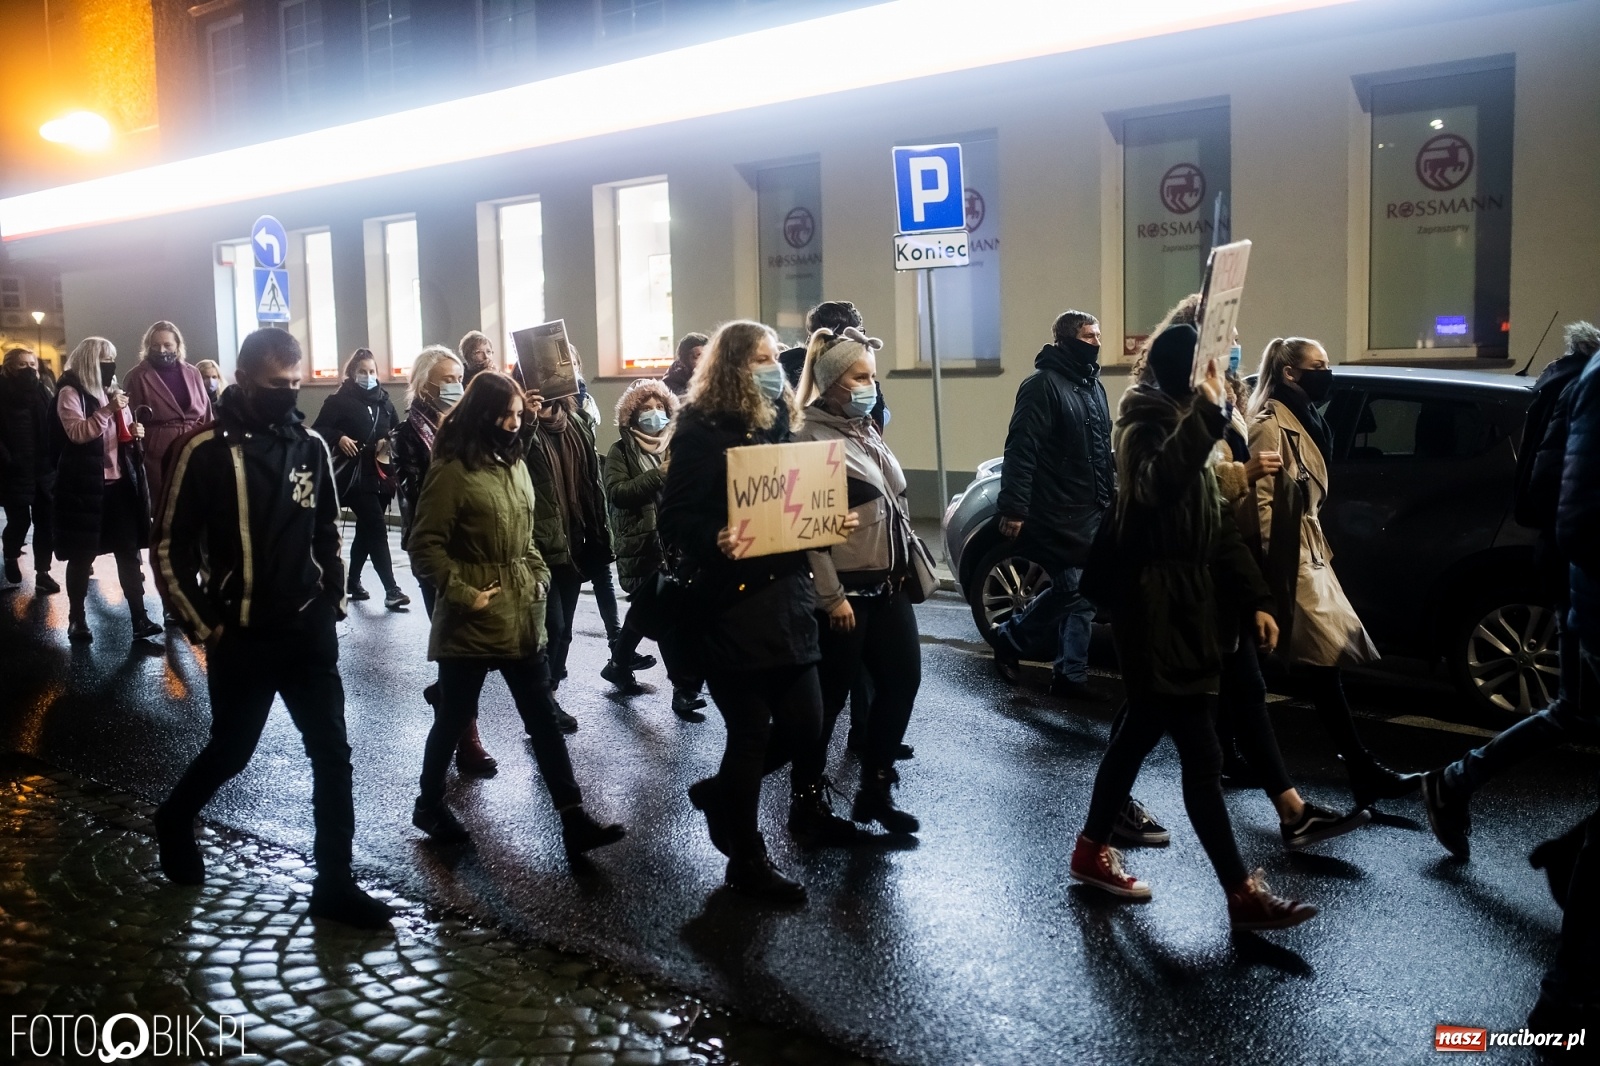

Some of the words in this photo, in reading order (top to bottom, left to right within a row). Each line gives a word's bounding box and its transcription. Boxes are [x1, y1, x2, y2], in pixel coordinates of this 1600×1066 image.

[909, 156, 949, 222] P
[1387, 195, 1503, 219] ROSSMANN
[896, 240, 967, 262] Koniec
[733, 466, 787, 508] WYBÓR
[811, 488, 835, 510] NIE
[797, 514, 847, 540] ZAKAZ
